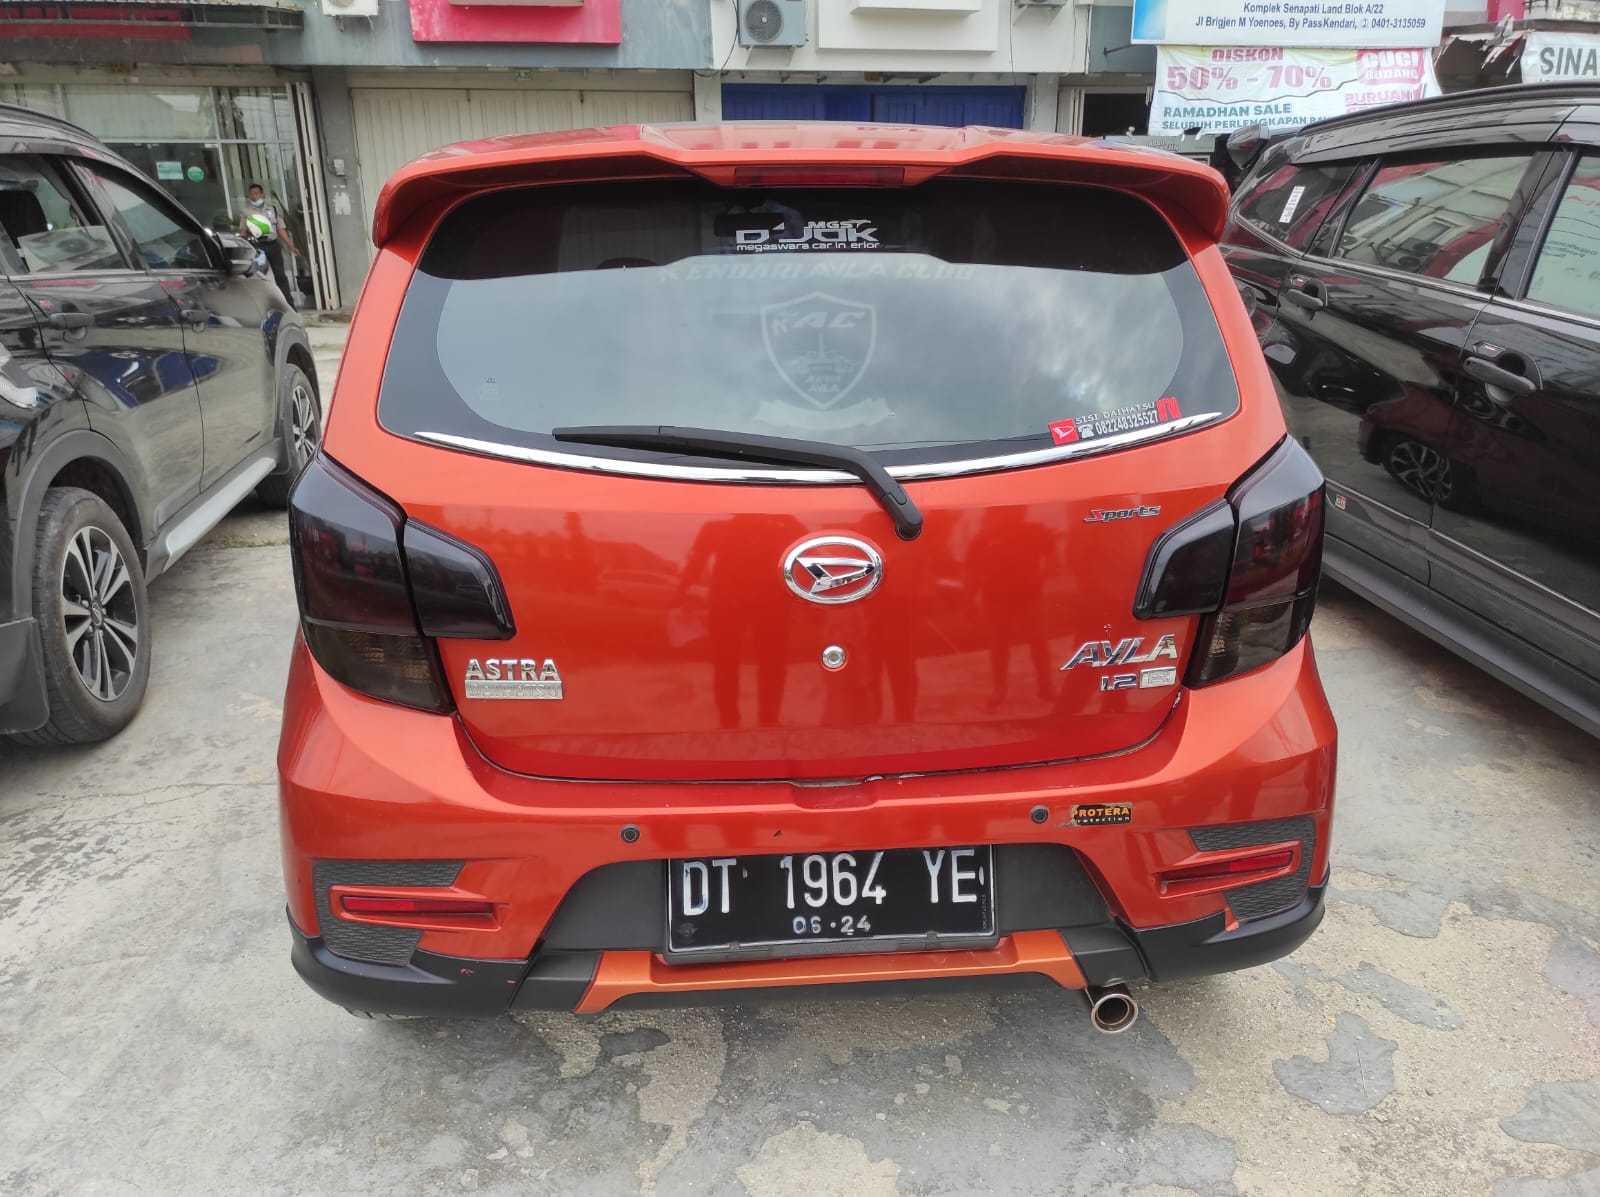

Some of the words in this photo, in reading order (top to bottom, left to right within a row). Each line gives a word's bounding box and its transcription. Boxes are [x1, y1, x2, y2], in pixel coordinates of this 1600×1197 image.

[1244, 3, 1281, 14] Komplek
[1283, 3, 1320, 15] Senapati
[1321, 4, 1342, 14] Land
[1345, 4, 1363, 14] Blok
[1365, 4, 1384, 14] A/22
[1206, 16, 1236, 29] Brigjen
[1238, 17, 1246, 26] M
[1249, 17, 1286, 28] Yoenoes,
[1289, 18, 1300, 30] By
[1371, 18, 1426, 28] 0401-3135059
[1211, 48, 1284, 62] DISKON
[1361, 51, 1419, 67] CUCI
[1540, 46, 1598, 76] SINA
[1167, 66, 1238, 91] 50%
[1266, 65, 1332, 89] 70%
[1163, 106, 1249, 118] RAMADHAN
[1253, 103, 1291, 116] SALE
[1162, 121, 1212, 130] SELURUH
[736, 242, 809, 252] megaswara
[812, 241, 832, 249] car
[1102, 402, 1155, 419] DAIHATSU
[1094, 410, 1159, 435] 082248325527
[1084, 505, 1162, 523] Sports
[1060, 633, 1178, 671] AYLA
[464, 658, 561, 681] ASTRA
[682, 858, 737, 916] DT
[780, 851, 886, 909] 1964
[922, 849, 977, 903] YE
